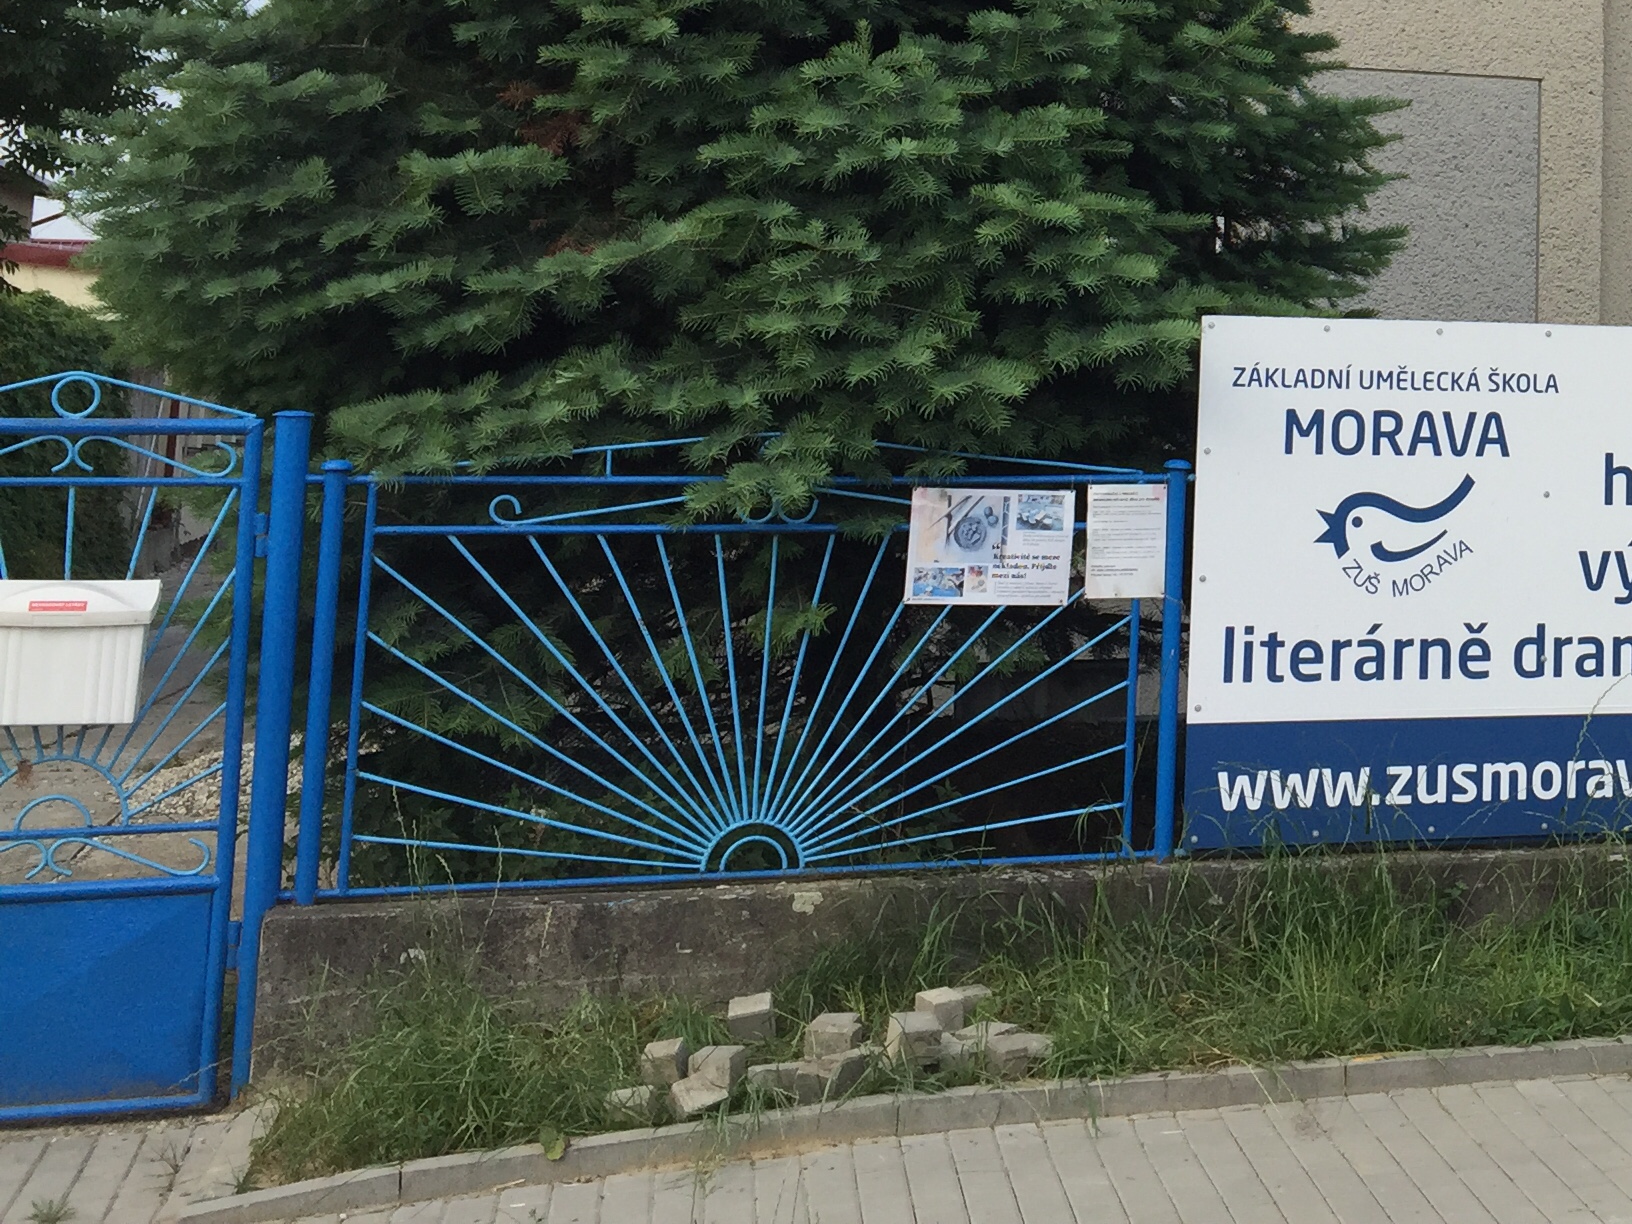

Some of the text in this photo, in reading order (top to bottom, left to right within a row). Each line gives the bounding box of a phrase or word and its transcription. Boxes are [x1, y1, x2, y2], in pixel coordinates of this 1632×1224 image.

[1231, 361, 1559, 395] ZÁKLADNÍ UMĚLECKÁ ŠKOLA
[1284, 408, 1510, 458] MORAVA
[1341, 539, 1474, 598] ZUŠ MORAVA
[1223, 622, 1492, 684] literárně
